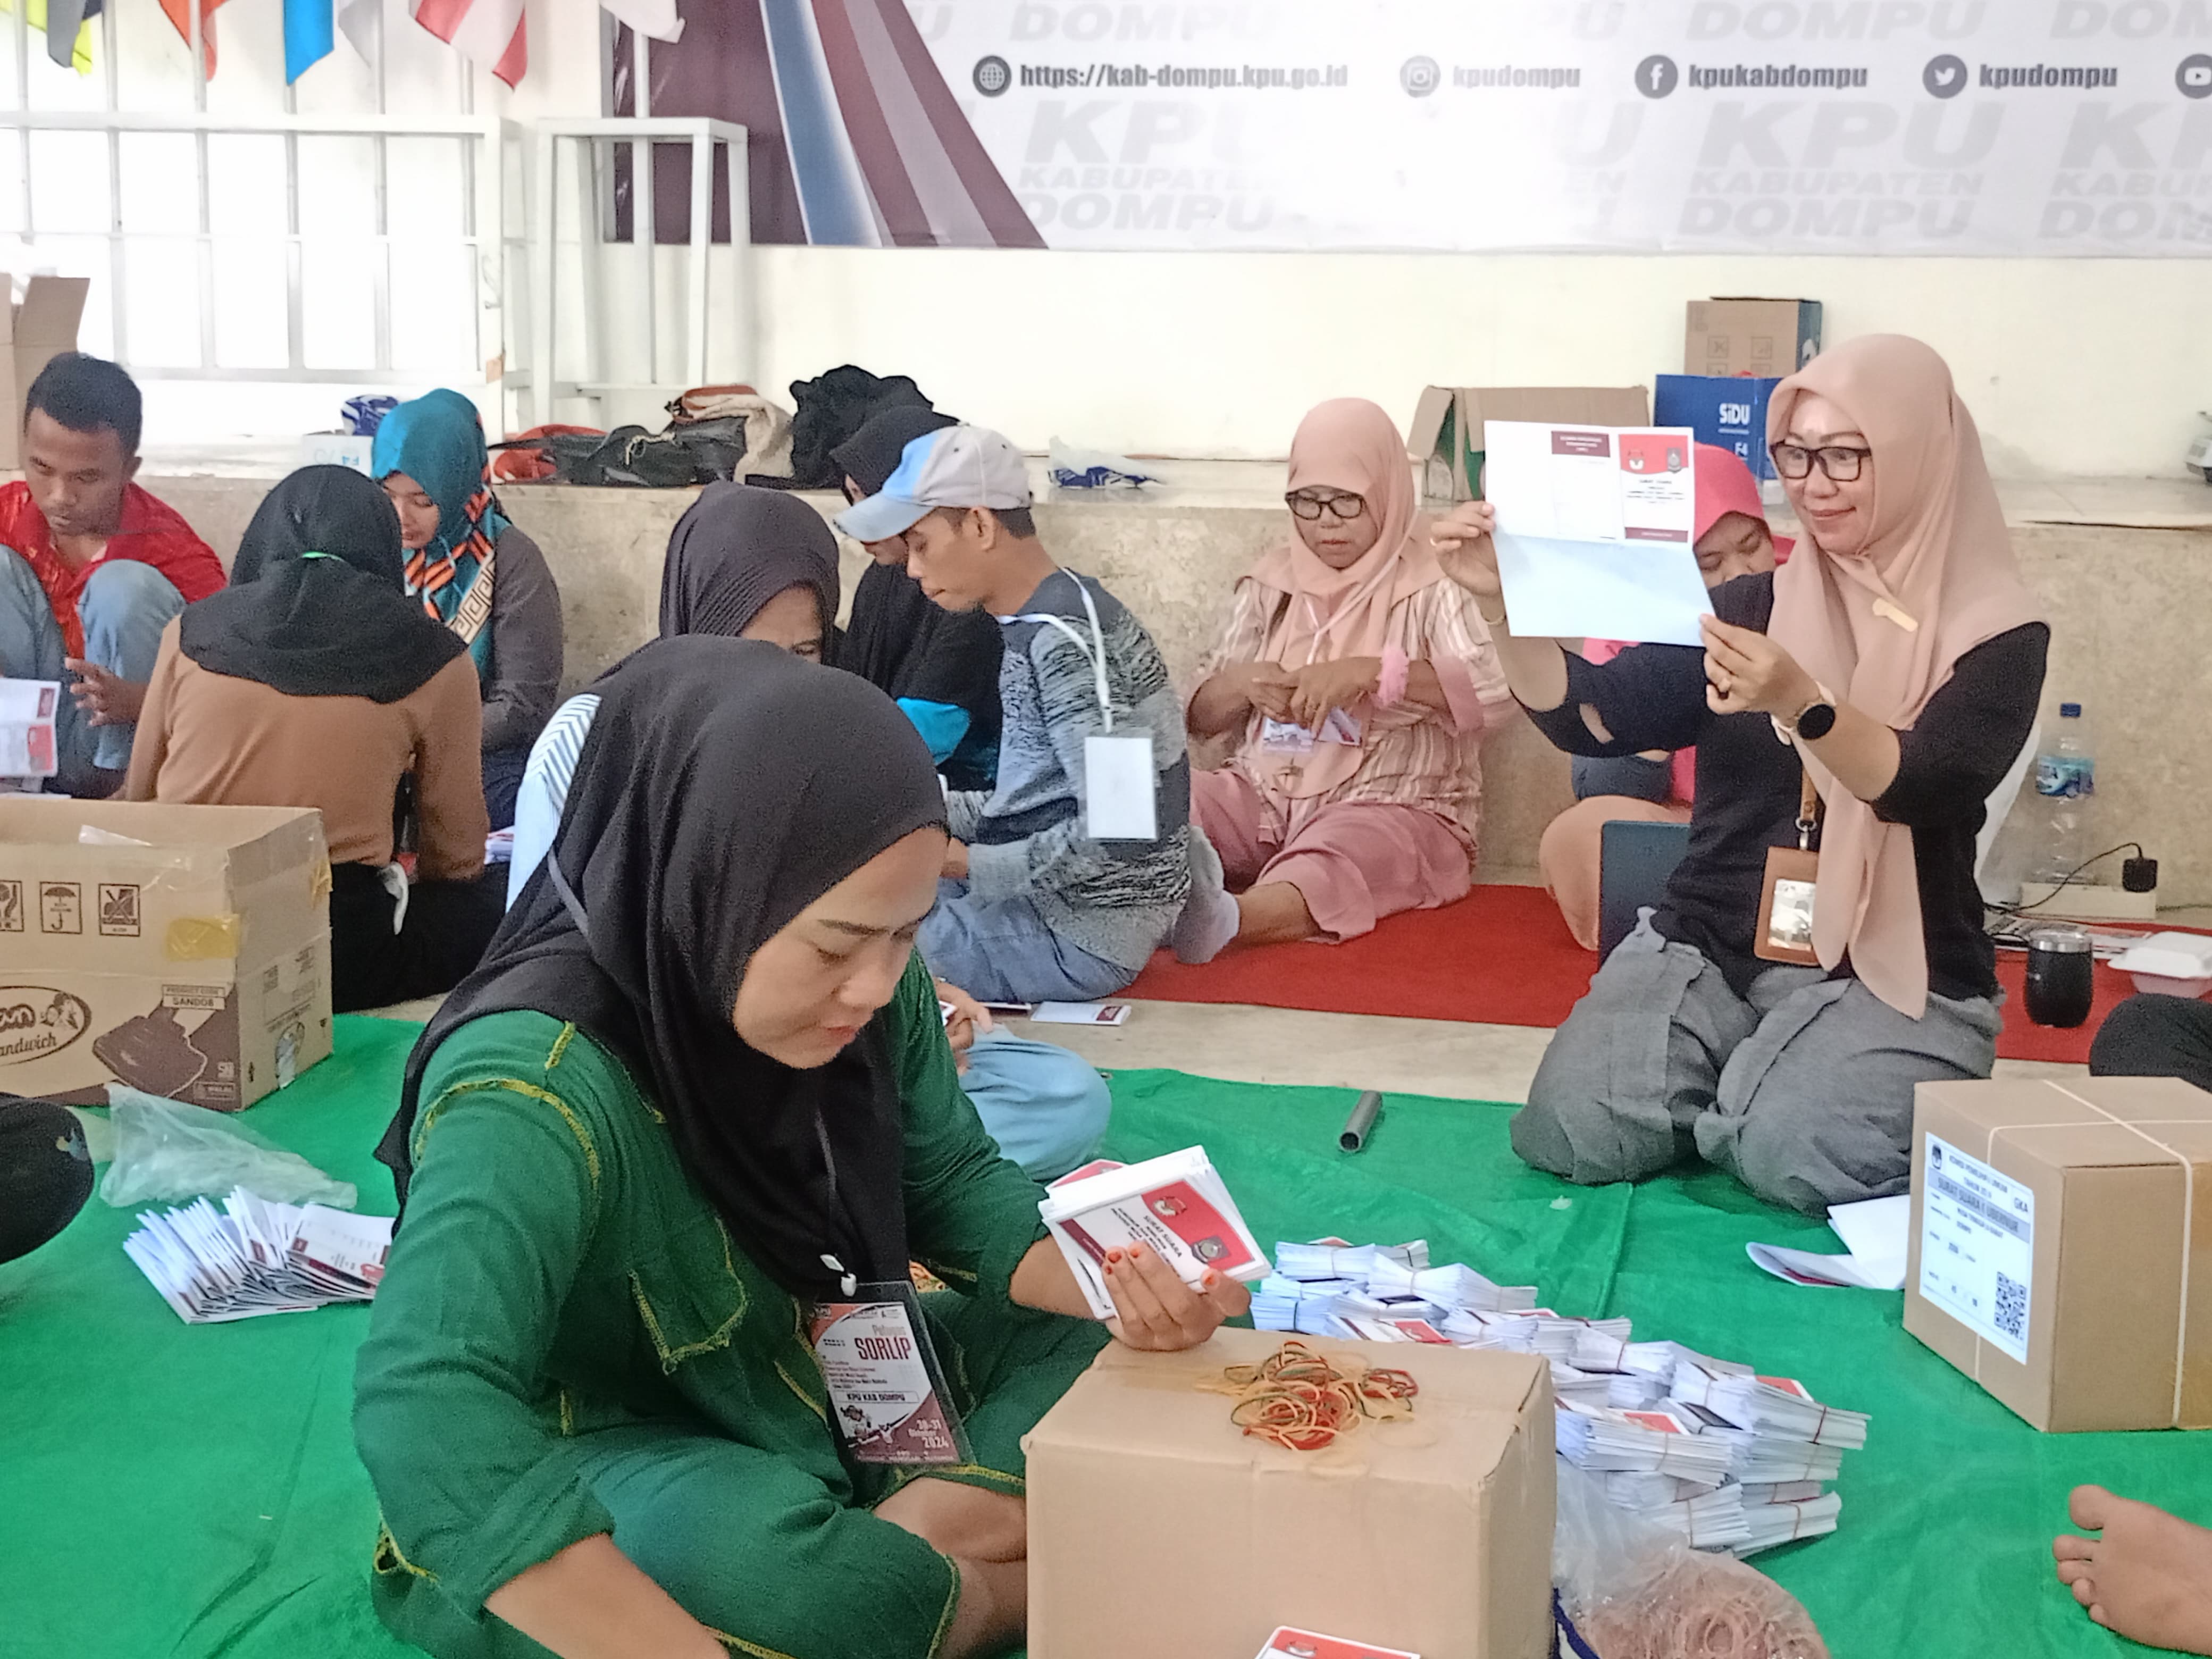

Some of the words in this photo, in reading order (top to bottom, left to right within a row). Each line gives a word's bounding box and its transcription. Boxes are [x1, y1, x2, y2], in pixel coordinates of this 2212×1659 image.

[1686, 0, 1988, 40] DOMPU
[2050, 0, 2212, 39] DOM
[1020, 64, 1347, 89] https://kab-dompu.kpu.go.id
[1453, 65, 1580, 89] kpudompu
[1688, 63, 1867, 90] kpukabdompu
[1979, 63, 2117, 90] kpudompu
[1696, 100, 2006, 169] KPU
[1689, 172, 1984, 195] KABUPATEN
[1677, 197, 1975, 238] DOMPU
[1735, 441, 1749, 456] F4
[0, 1032, 57, 1056] andwich
[854, 1336, 911, 1360] SORLIP
[922, 1437, 950, 1449] 2024
